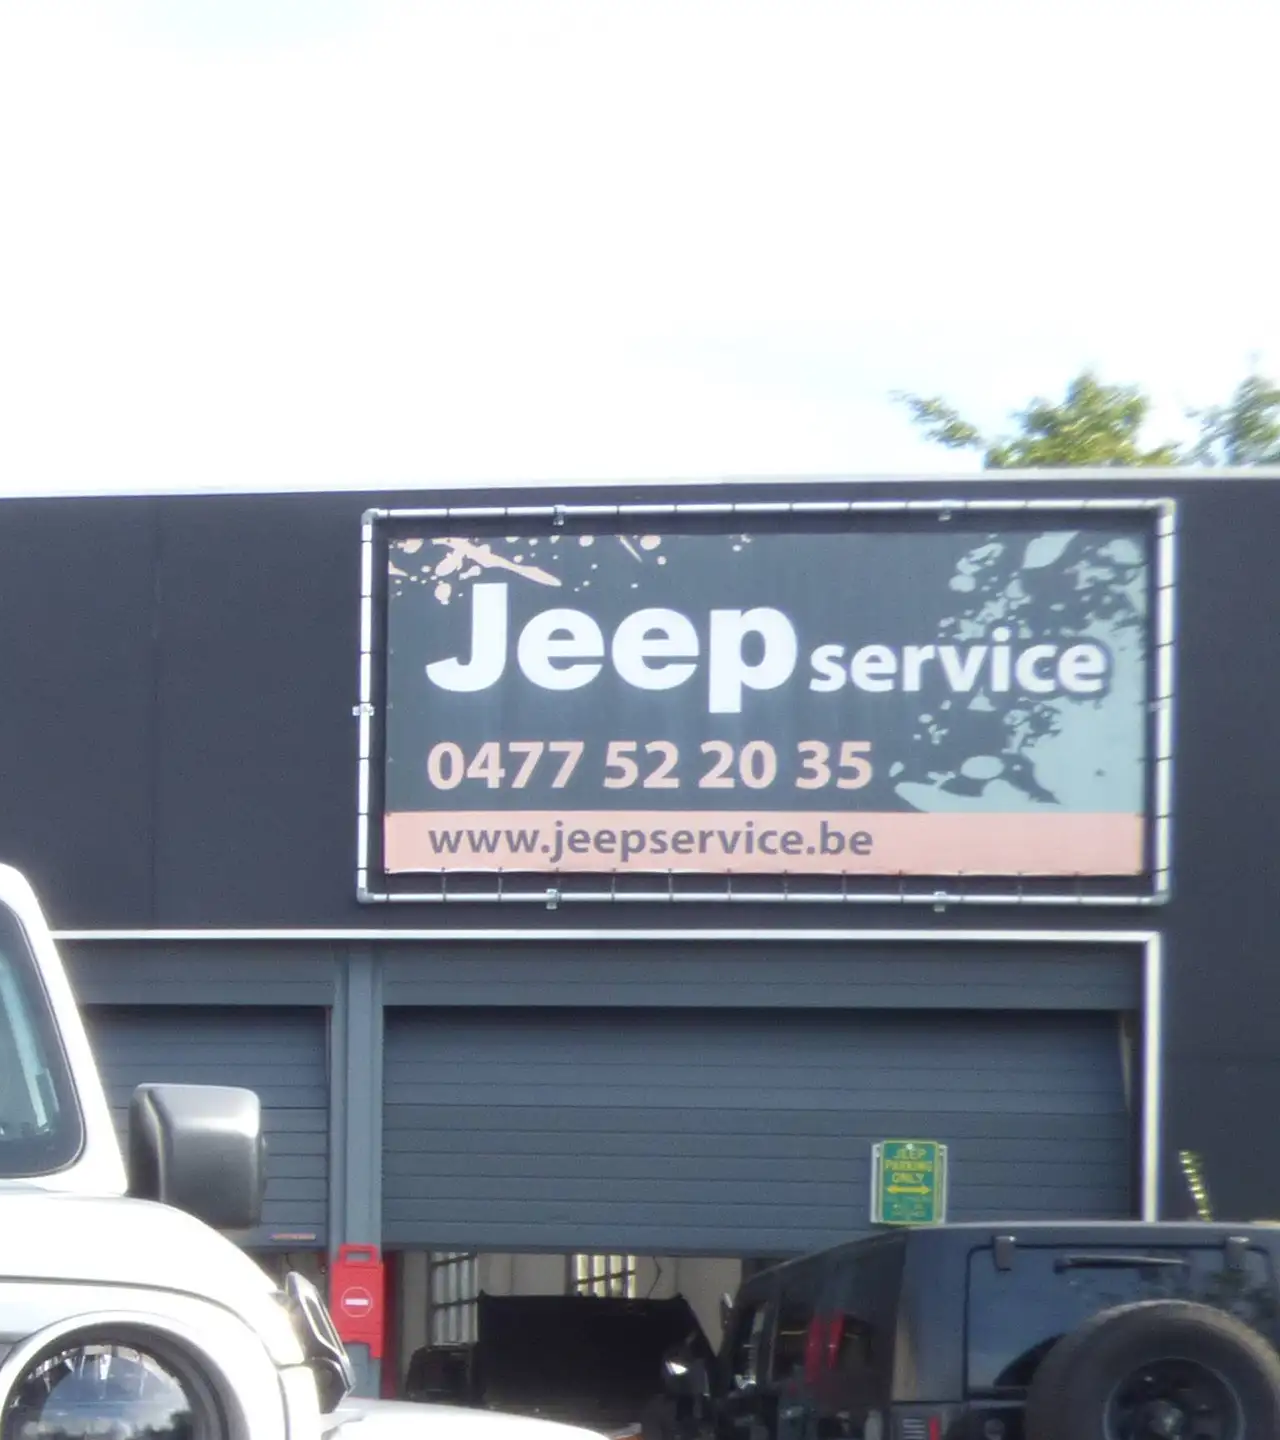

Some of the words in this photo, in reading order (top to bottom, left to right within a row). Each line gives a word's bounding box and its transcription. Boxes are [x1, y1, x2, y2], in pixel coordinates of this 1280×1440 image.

[426, 583, 798, 713] Jeep
[809, 627, 1107, 693] service
[427, 741, 584, 790] 0477
[605, 741, 679, 789] 52
[700, 741, 776, 789] 20
[796, 740, 873, 788] 35
[428, 820, 874, 864] www.jeepservice.be
